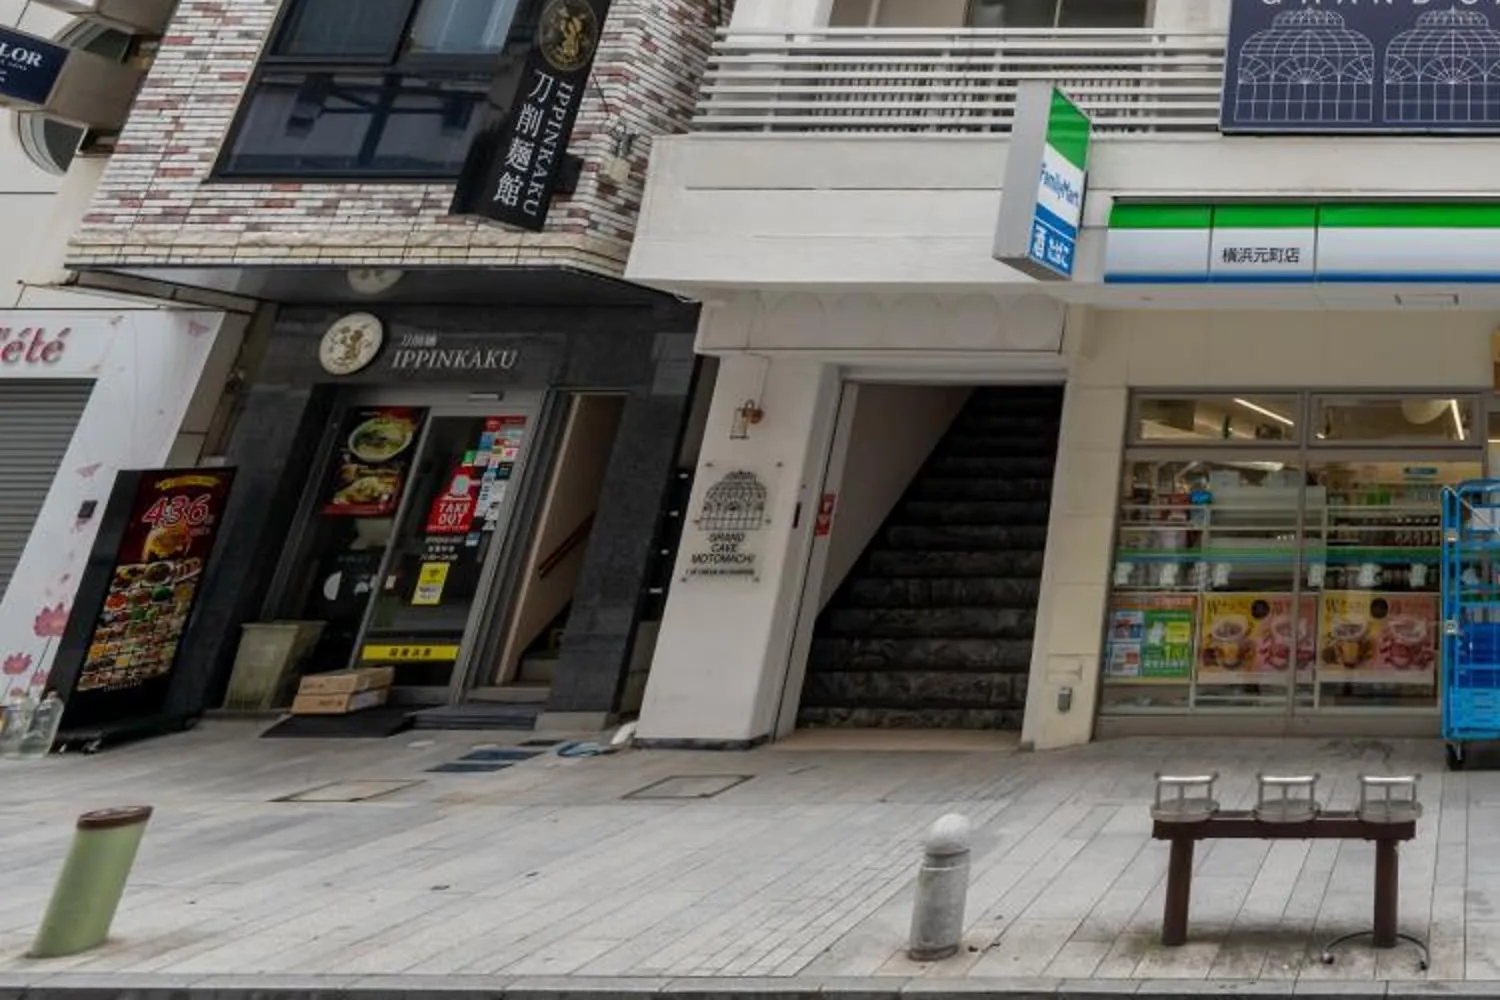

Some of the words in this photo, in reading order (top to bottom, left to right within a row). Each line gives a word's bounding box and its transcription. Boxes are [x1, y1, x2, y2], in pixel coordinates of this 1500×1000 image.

[523, 81, 575, 216] IPPINKAKU
[1040, 162, 1080, 207] FamilyMart
[1222, 247, 1300, 263] 横浜元町店
[392, 349, 518, 369] IPPINKAKU
